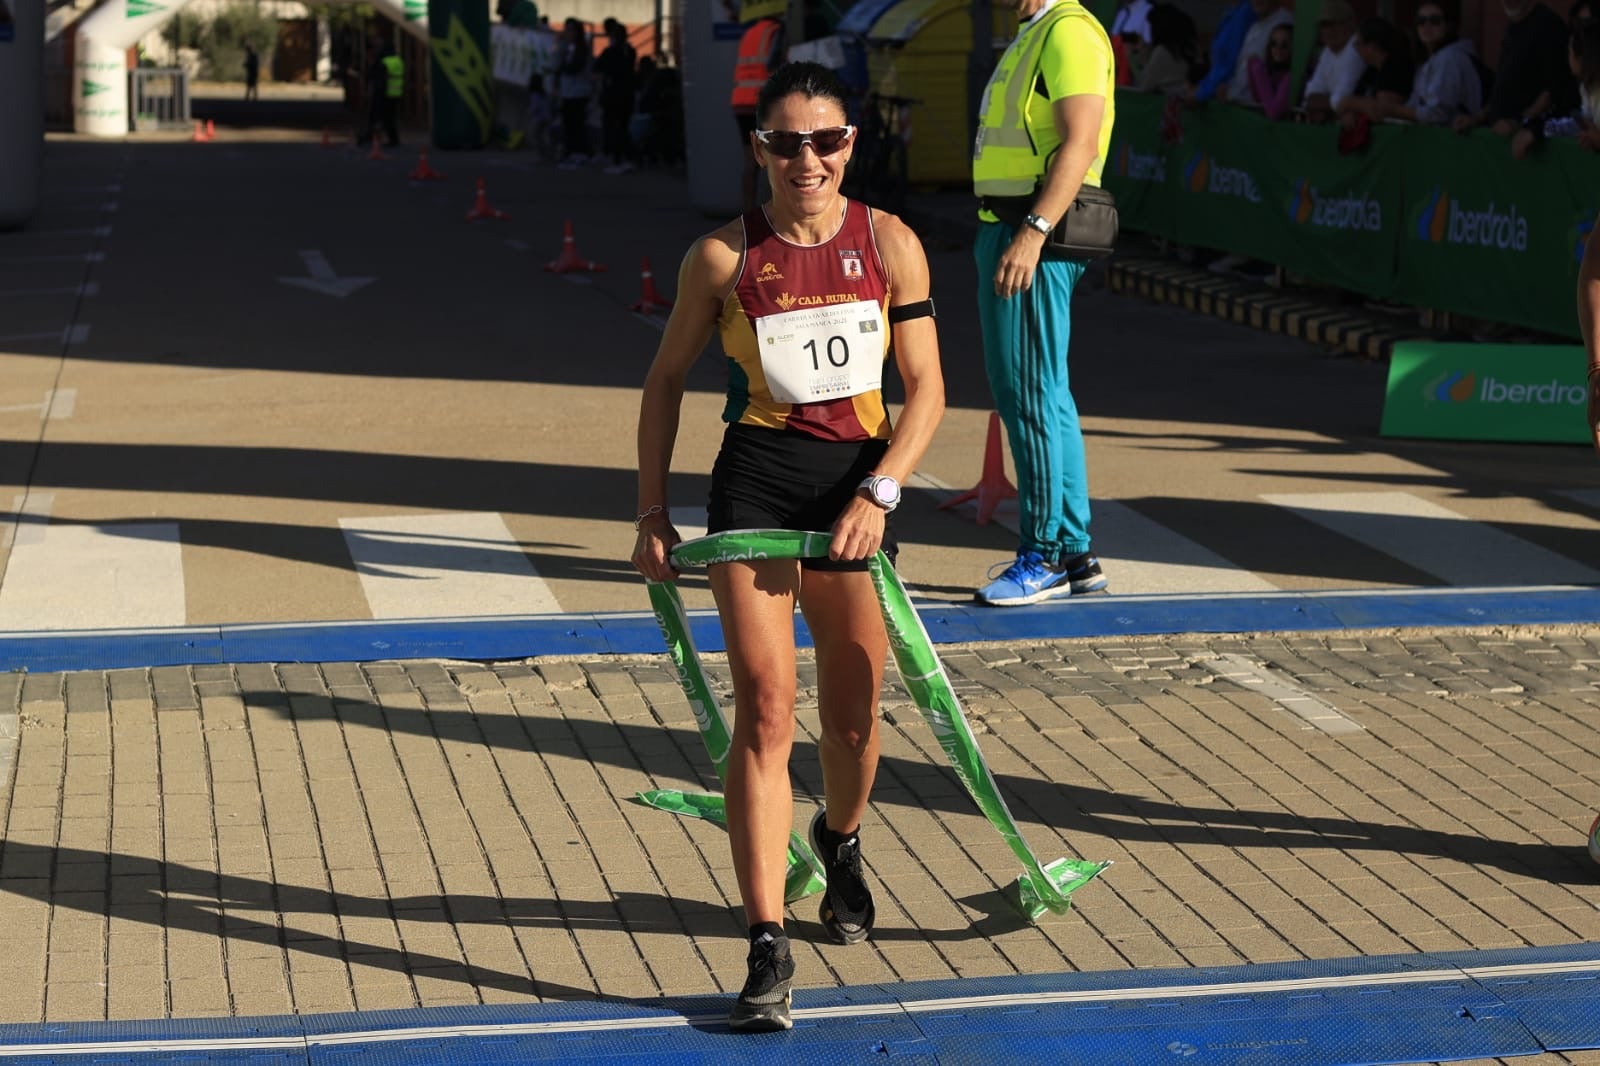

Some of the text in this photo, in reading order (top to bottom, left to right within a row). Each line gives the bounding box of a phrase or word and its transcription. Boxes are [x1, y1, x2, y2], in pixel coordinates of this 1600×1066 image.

[1449, 200, 1527, 251] Iberdrola
[798, 293, 861, 306] CAJA RURAL
[802, 335, 850, 371] 10
[1481, 376, 1586, 405] Iberdro
